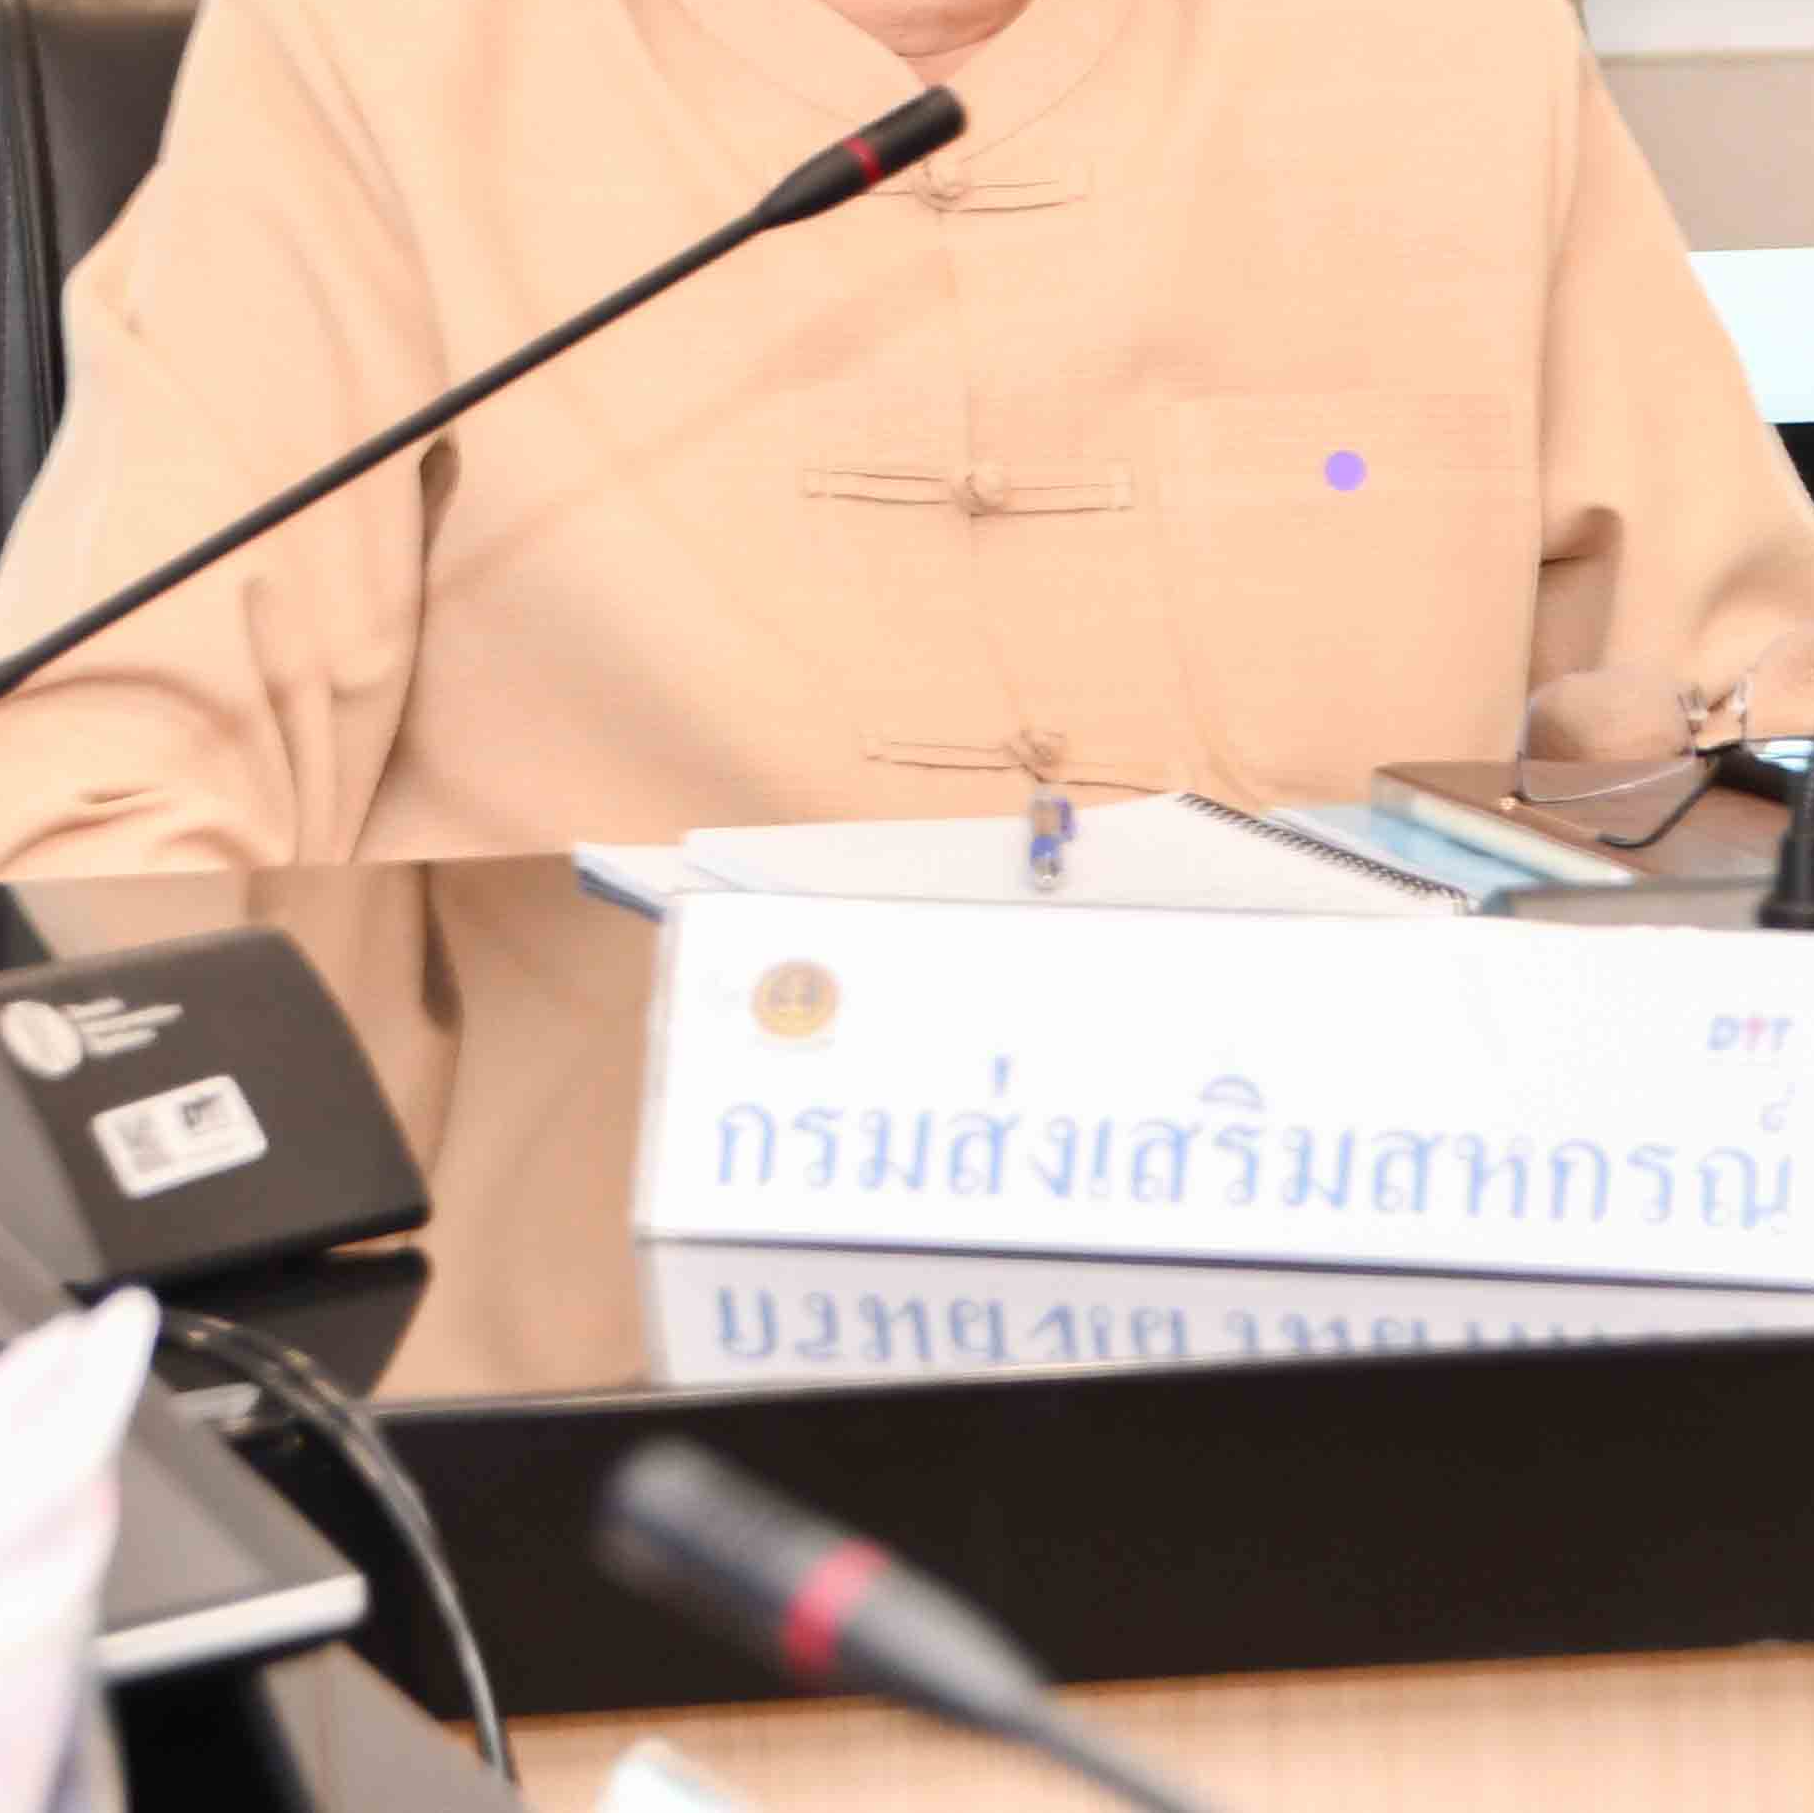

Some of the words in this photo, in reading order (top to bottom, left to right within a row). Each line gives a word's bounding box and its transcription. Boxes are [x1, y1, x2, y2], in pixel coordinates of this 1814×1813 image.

[715, 1056, 1791, 1230] กรมส่งเสริมสหกรณ์
